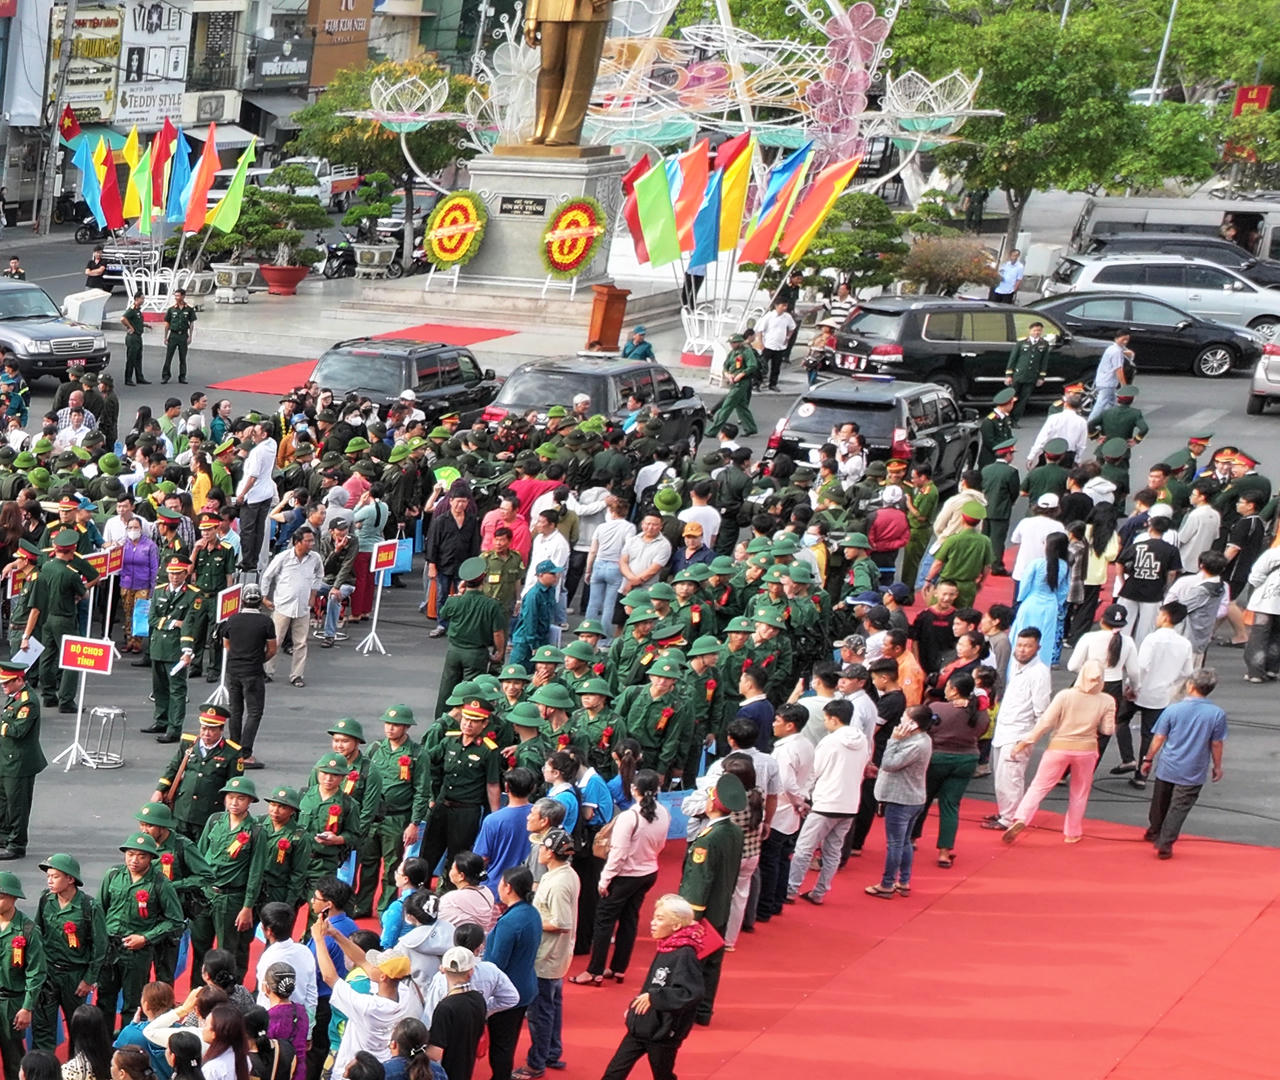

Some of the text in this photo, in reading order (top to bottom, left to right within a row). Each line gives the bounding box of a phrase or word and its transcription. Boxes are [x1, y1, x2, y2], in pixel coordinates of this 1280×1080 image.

[128, 93, 182, 109] TEDDY STYLE
[1134, 544, 1161, 580] LA
[70, 644, 104, 656] BỘ CHQS
